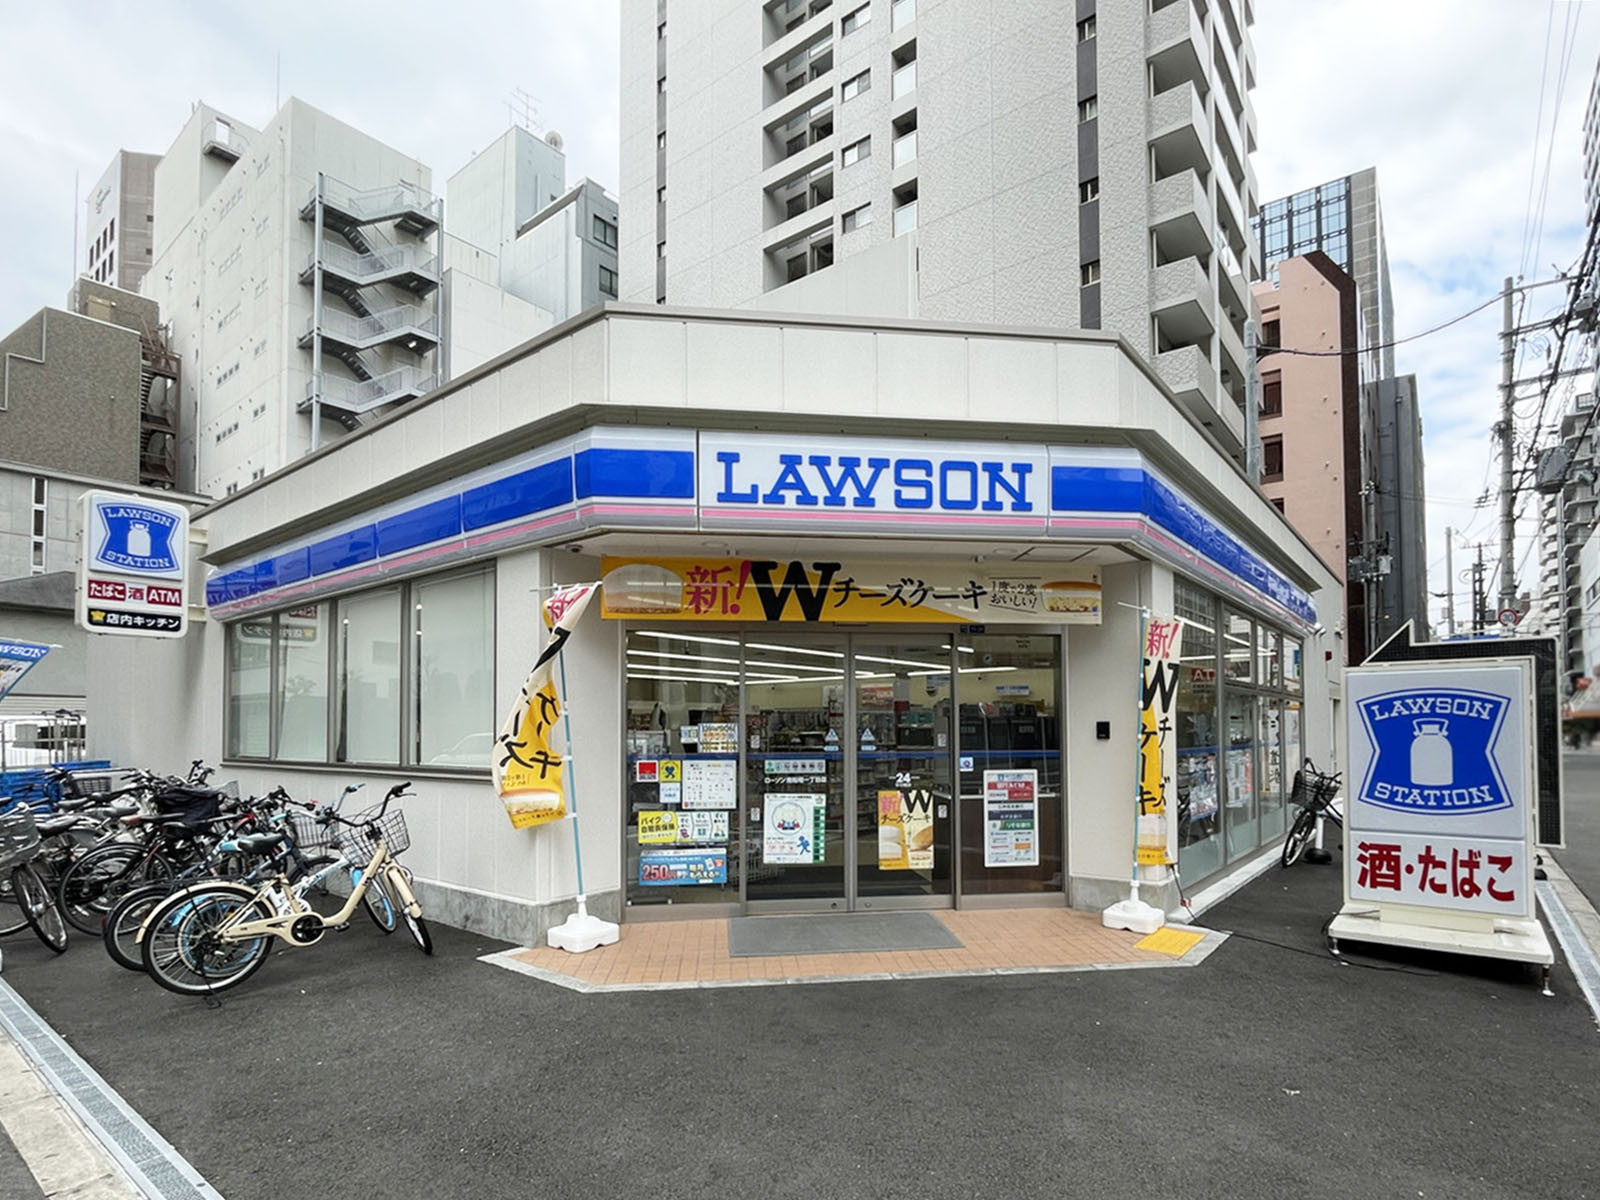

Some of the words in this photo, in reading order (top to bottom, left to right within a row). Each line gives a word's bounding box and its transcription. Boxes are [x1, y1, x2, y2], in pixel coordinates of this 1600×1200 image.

[717, 451, 1033, 512] LAWSON
[105, 508, 173, 527] LAWSON
[105, 550, 171, 568] STATION
[90, 582, 125, 599] たばこ
[128, 586, 144, 600] 酒
[148, 590, 180, 604] ATM
[685, 560, 751, 615] 新!
[750, 560, 841, 621] W
[832, 577, 988, 610] チーズケーキ
[106, 613, 179, 628] 店内キッチン
[1147, 620, 1179, 659] 新!
[1190, 668, 1217, 682] AT
[1371, 697, 1494, 721] LAWSON
[1138, 723, 1158, 816] ケーキ
[1153, 716, 1173, 807] チーズ
[896, 772, 911, 784] 24
[1373, 782, 1494, 807] STATION
[1356, 841, 1515, 902] 酒・たばこ
